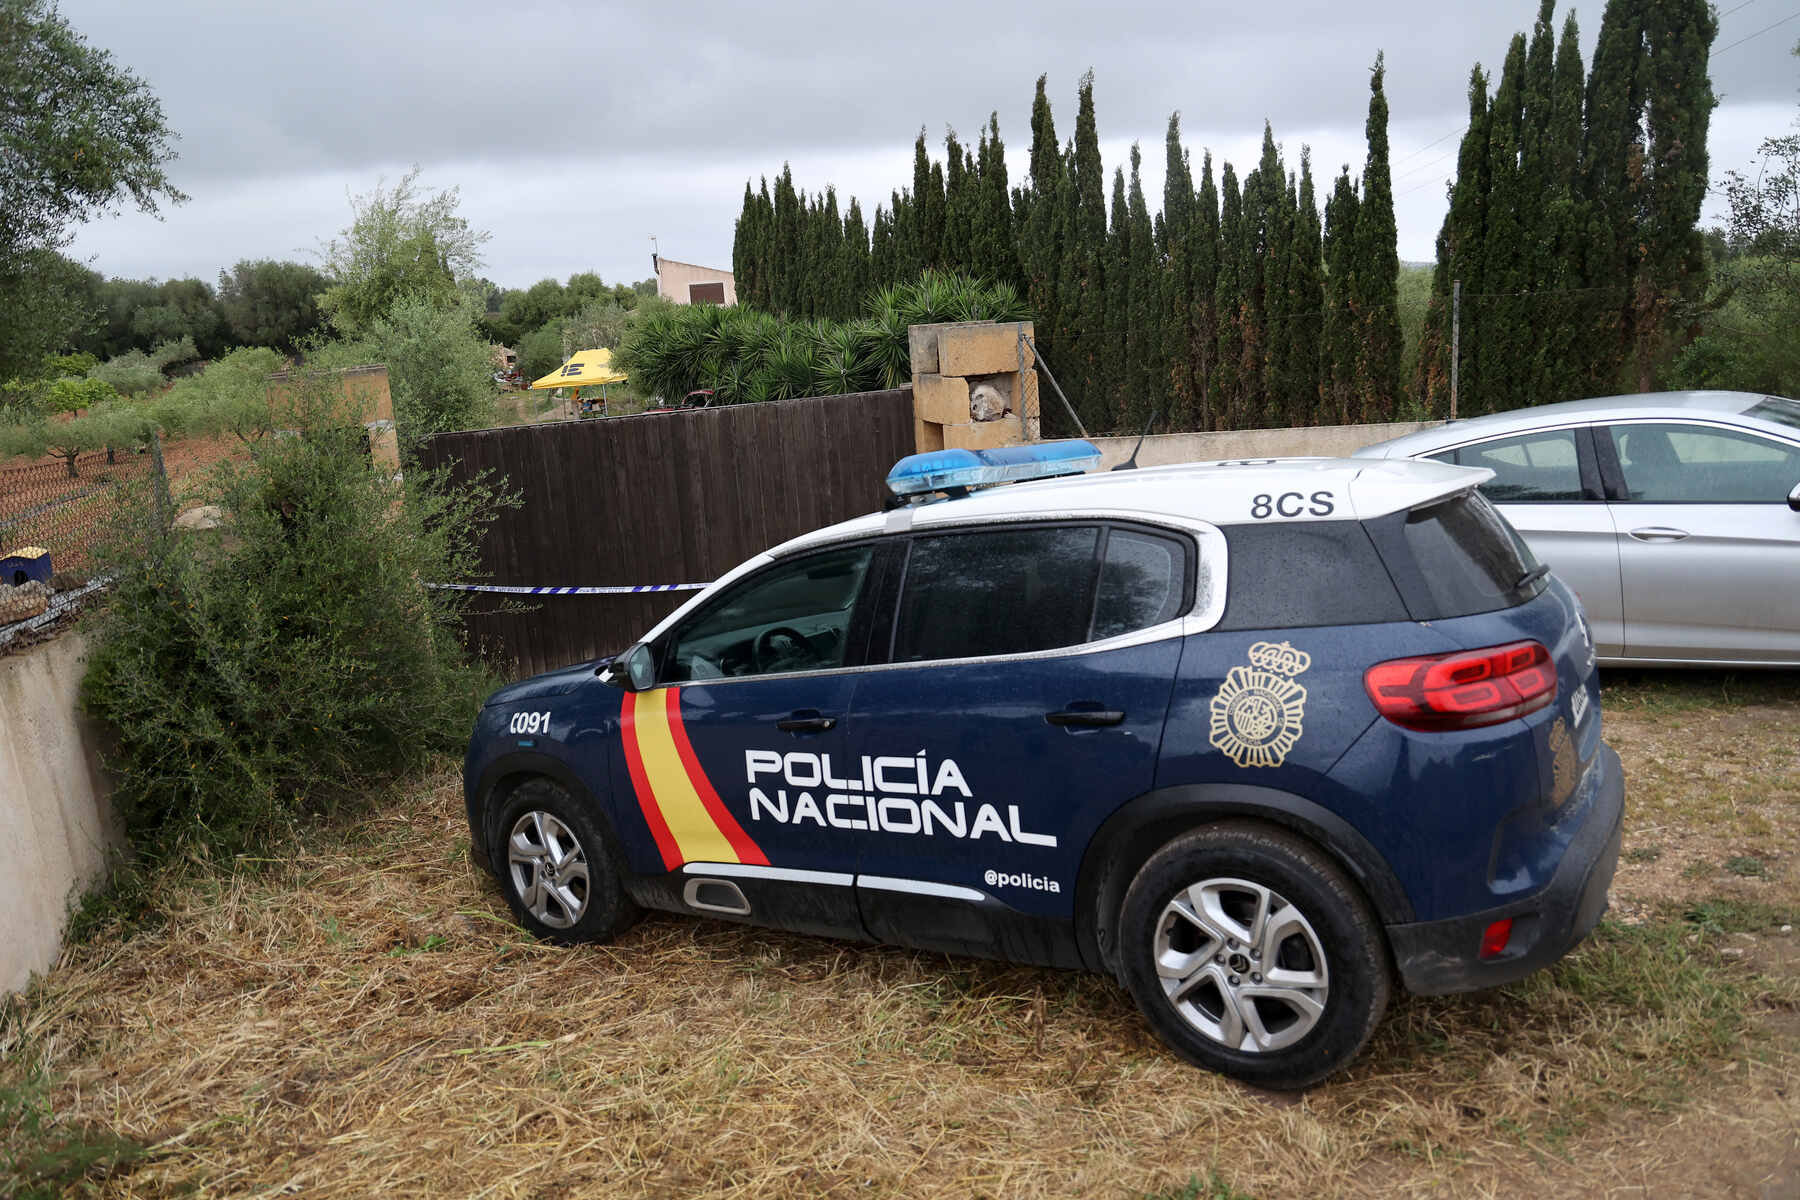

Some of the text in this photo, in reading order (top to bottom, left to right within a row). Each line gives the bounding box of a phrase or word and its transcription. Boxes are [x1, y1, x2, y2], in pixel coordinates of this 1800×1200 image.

[1250, 491, 1334, 519] 8CS
[745, 749, 973, 797] POLICÍA
[749, 788, 1057, 847] NACIONAL
[984, 869, 1060, 893] @policia
